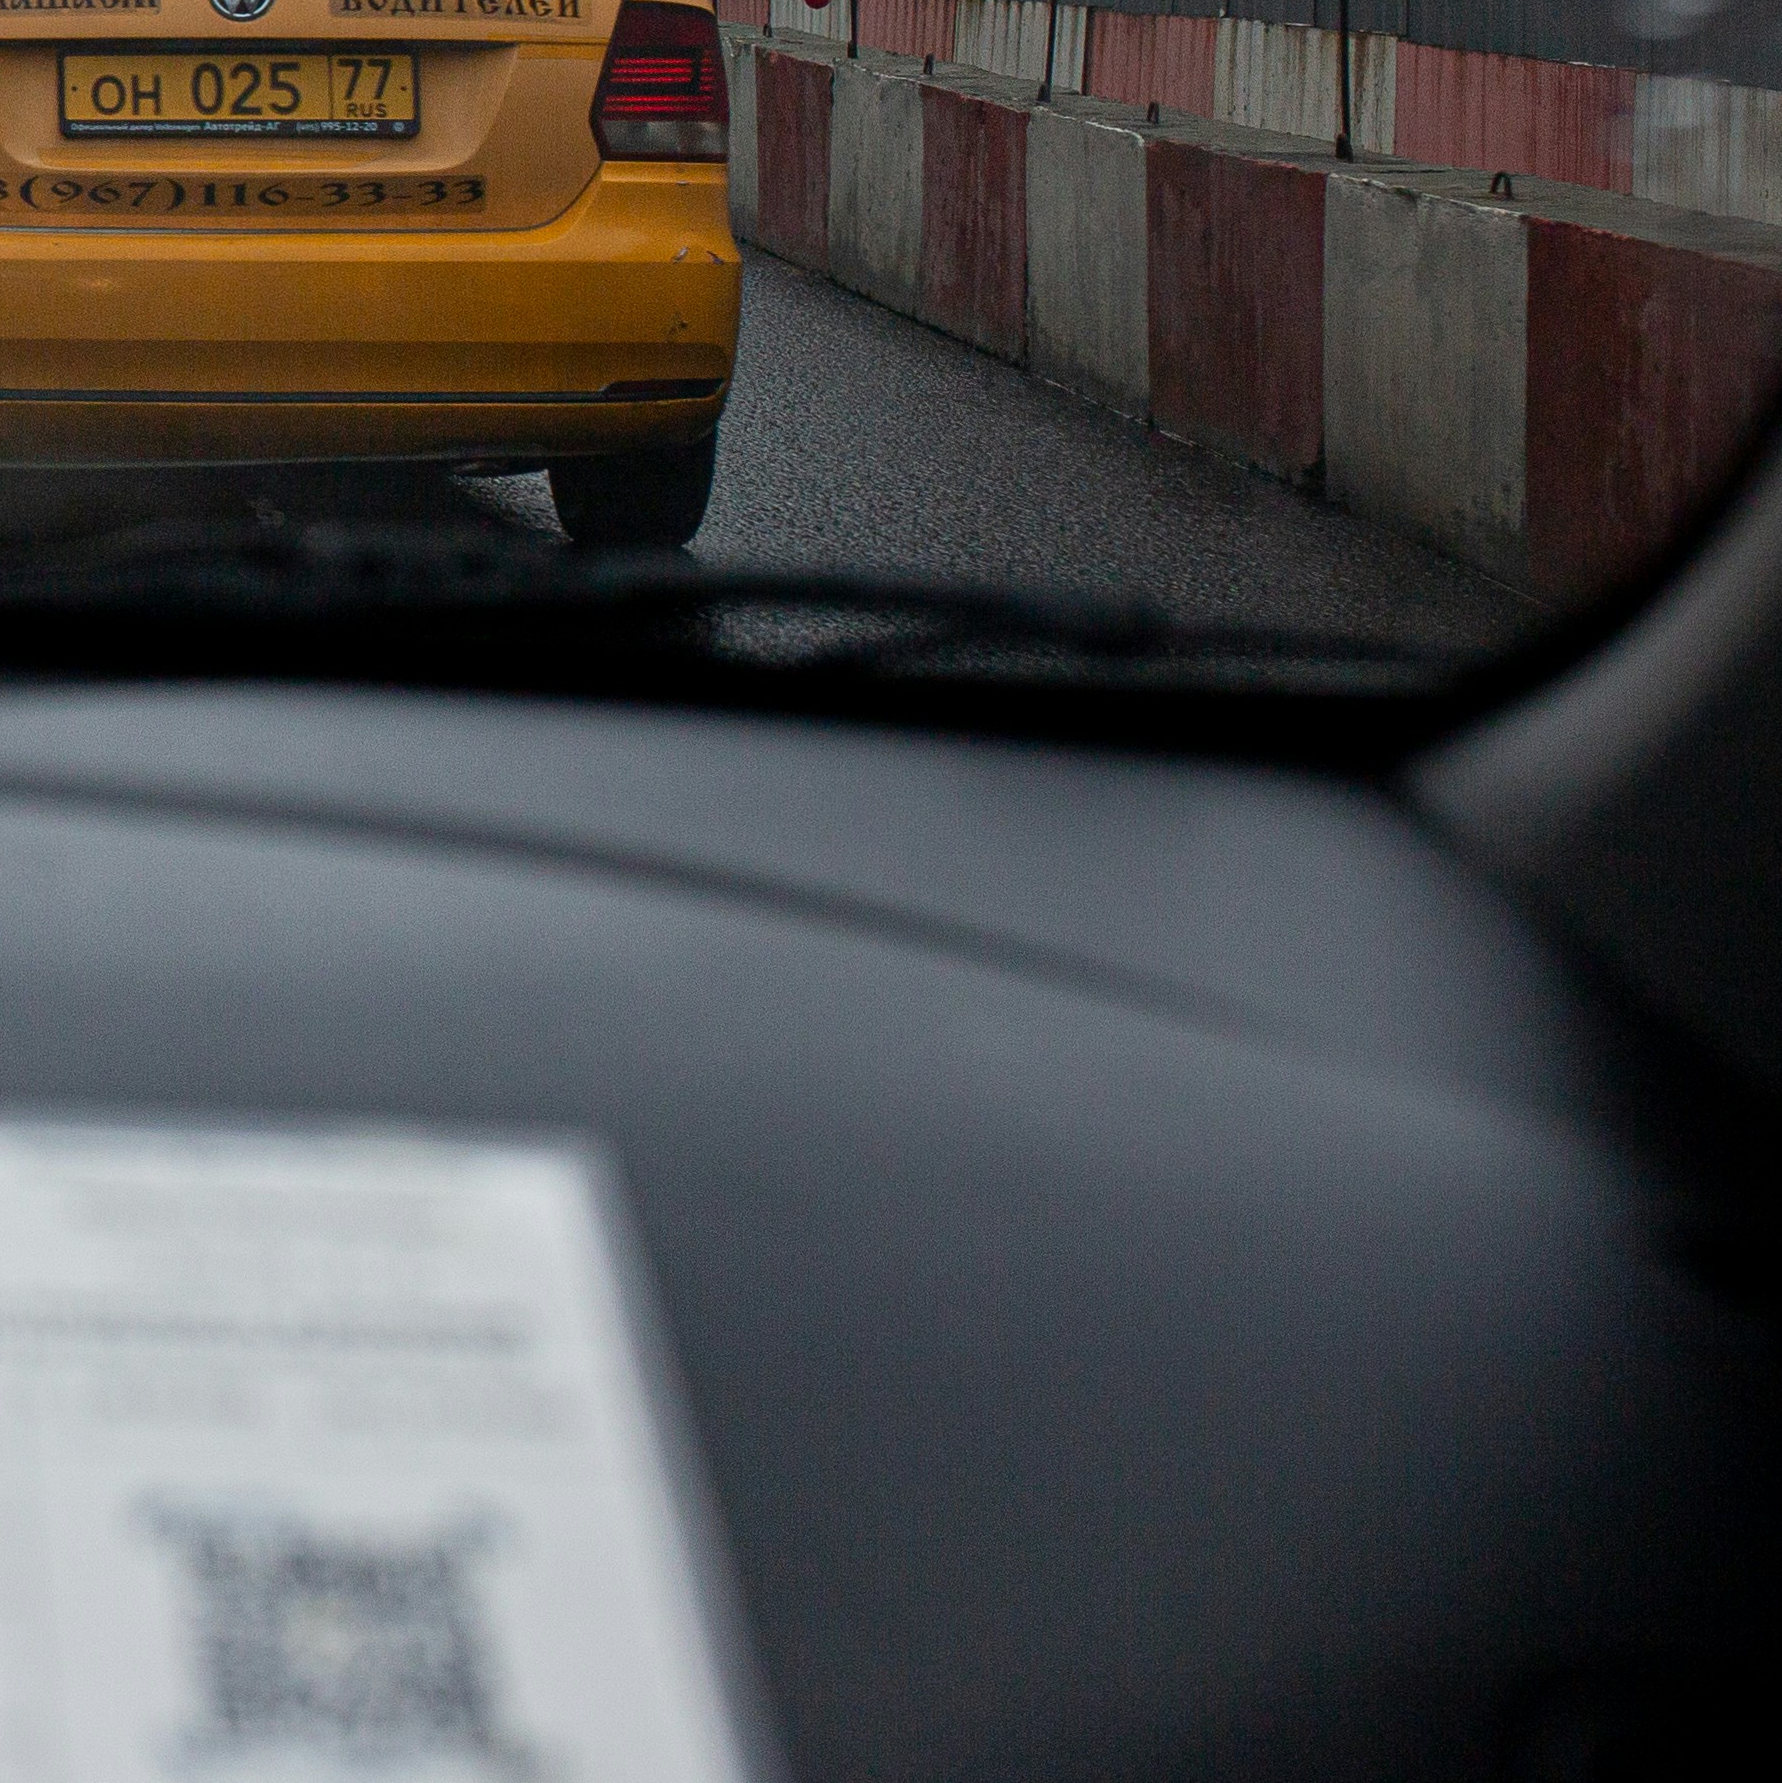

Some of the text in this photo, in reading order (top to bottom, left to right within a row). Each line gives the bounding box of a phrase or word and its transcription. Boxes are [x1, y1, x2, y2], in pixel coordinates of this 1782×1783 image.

[91, 58, 395, 116] ОН 025 77
[346, 101, 389, 118] RUS
[203, 121, 280, 133] Автотрейд-АГ
